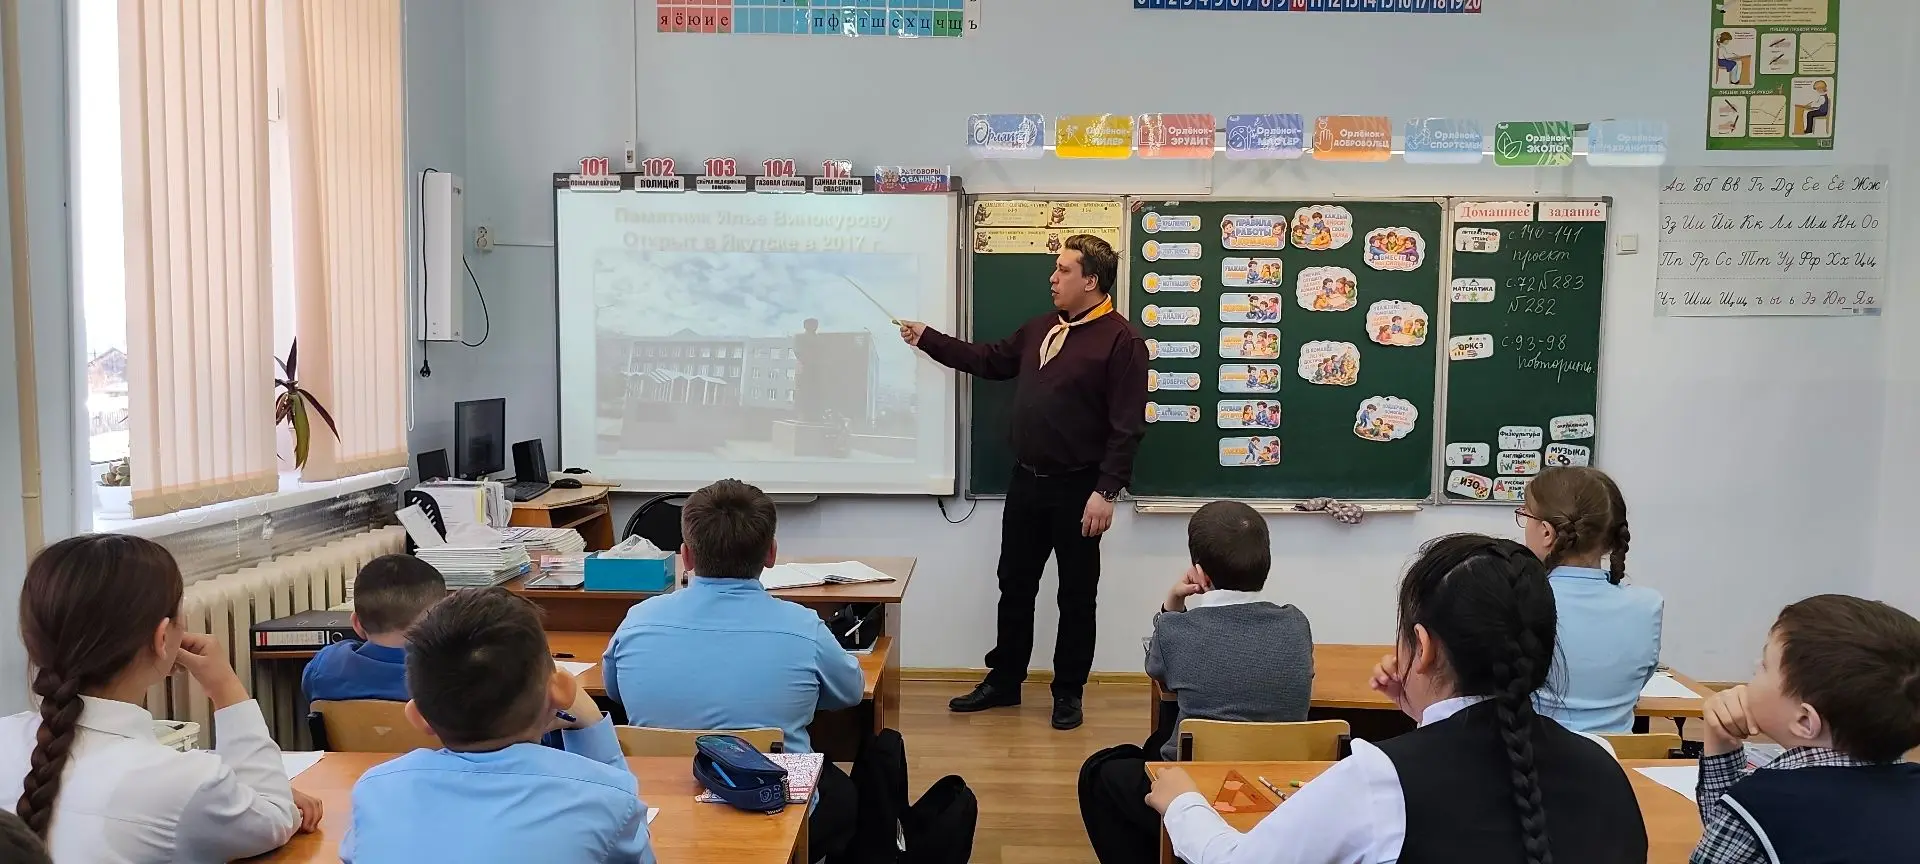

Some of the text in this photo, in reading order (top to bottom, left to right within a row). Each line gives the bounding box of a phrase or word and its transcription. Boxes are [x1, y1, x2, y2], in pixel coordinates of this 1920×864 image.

[660, 16, 668, 25] я
[675, 12, 683, 26] ё
[688, 16, 701, 26] ю
[705, 16, 714, 26] и
[721, 16, 729, 26] е
[815, 18, 823, 28] п
[828, 13, 838, 31] ф
[859, 18, 867, 28] т
[871, 18, 886, 28] ш
[892, 18, 900, 29] с
[906, 18, 914, 29] х
[921, 18, 930, 30] ц
[936, 18, 945, 29] ч
[949, 18, 962, 32] щ
[969, 20, 978, 30] ъ
[1168, 126, 1212, 137] Орлёнок-
[1340, 129, 1384, 140] Орлёнок-
[1171, 137, 1209, 146] ЭРУДИТ
[1334, 139, 1389, 149] ДОБРОВОЛЕЦ
[1525, 133, 1570, 144] Орлёнок-
[1526, 143, 1568, 154] ЭКОЛОГ
[581, 159, 608, 176] 101
[643, 159, 674, 177] 102
[705, 159, 735, 177] 103
[765, 160, 793, 177] 104
[641, 179, 679, 189] ПОЛИЦИЯ
[1663, 174, 1881, 197] Аа Бб Вв Гг Дд Ее Ёё Жж
[1460, 206, 1601, 218] Домашнее задание
[615, 207, 891, 232] Памятник Илье Винокурову
[1236, 219, 1272, 227] ПРАВИЛА
[1662, 212, 1879, 234] Зз Ии Йй Кк Лл Мм Нн Оо
[1236, 228, 1271, 236] РАБОТЫ
[623, 232, 690, 252] Открыт
[721, 233, 799, 253] Якутске
[823, 235, 866, 252] 2017
[1513, 248, 1571, 270] проект
[1660, 250, 1877, 272] Пп Рр Сс Тт Уу Фф Хх Цц
[1658, 291, 1676, 305] Чч
[1684, 291, 1711, 305] Шш
[1720, 291, 1748, 307] Щщ
[1802, 291, 1817, 305] Ээ
[1823, 291, 1846, 305] Юю
[1853, 290, 1875, 305] Яя
[1458, 342, 1483, 350] ОРКСЭ
[1500, 430, 1540, 439] Физкультура
[1460, 446, 1476, 454] ТРУД
[1551, 446, 1586, 456] МУЗЫКА
